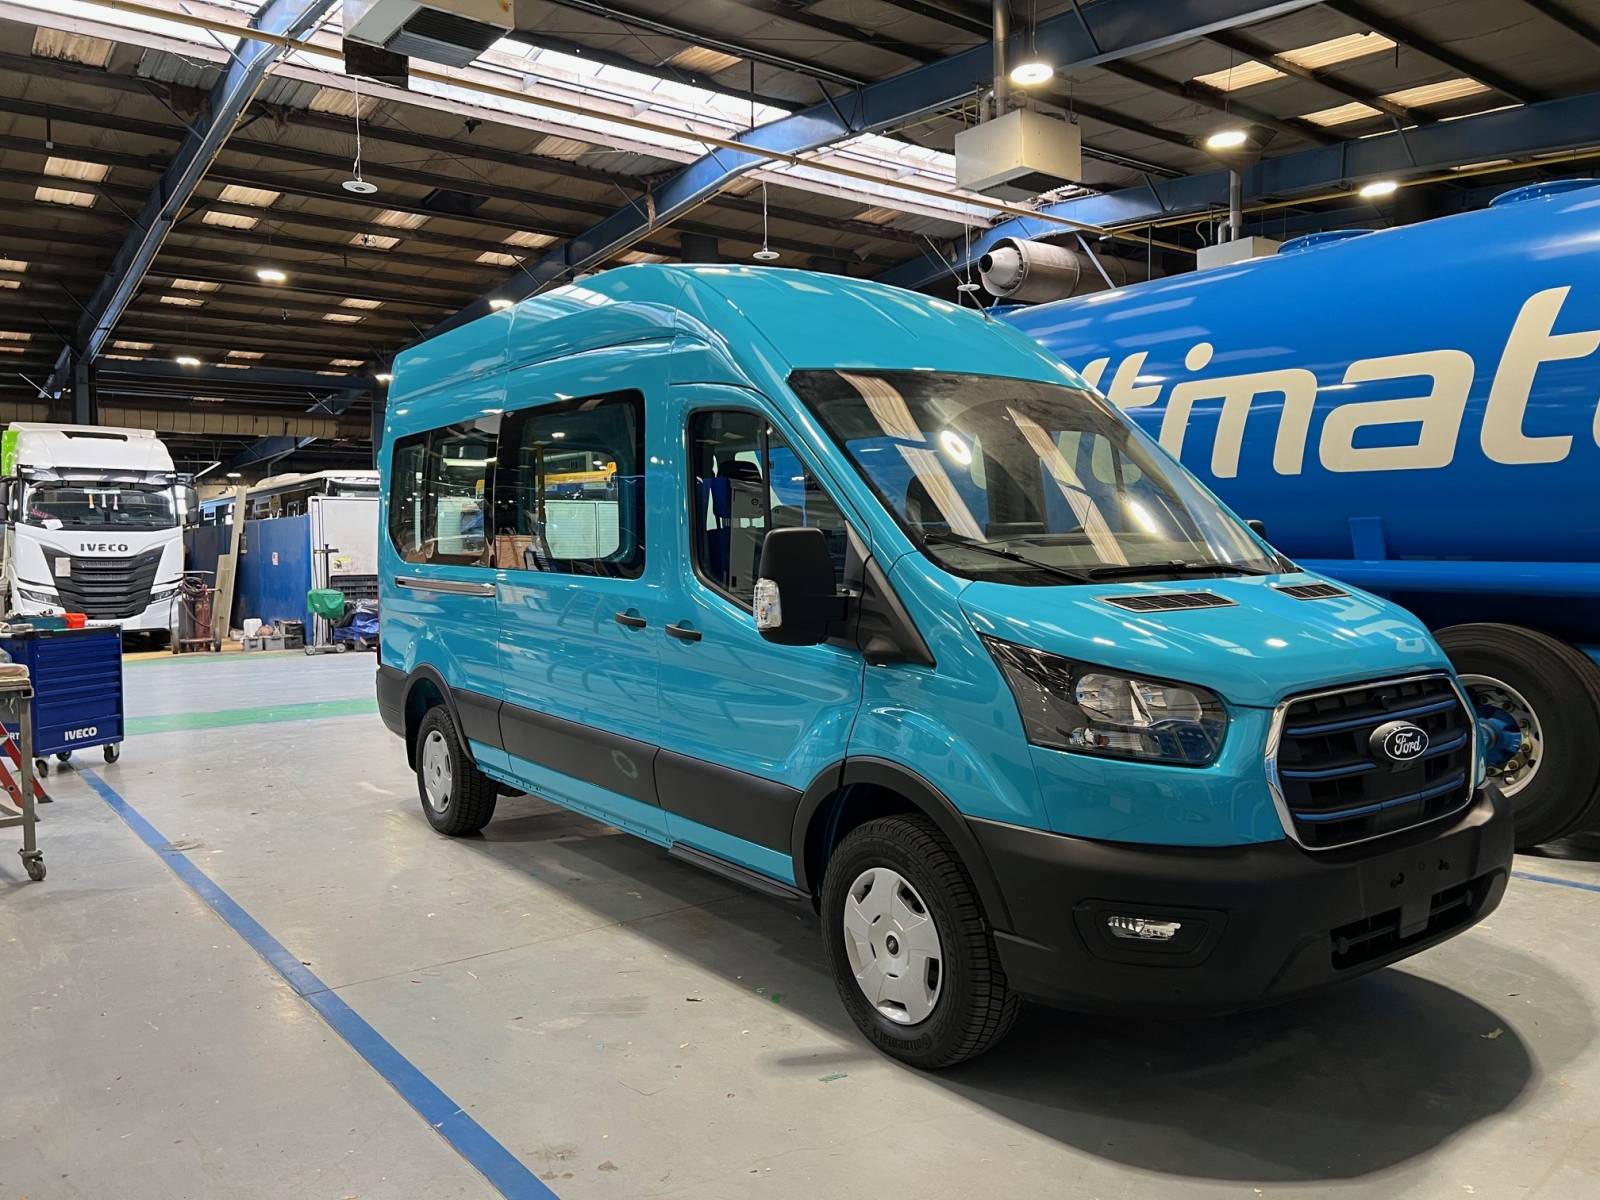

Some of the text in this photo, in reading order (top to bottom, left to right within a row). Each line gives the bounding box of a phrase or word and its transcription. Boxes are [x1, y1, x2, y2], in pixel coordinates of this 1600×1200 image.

[80, 543, 129, 552] IVECO
[64, 726, 98, 742] IVECO
[1394, 732, 1422, 756] Ford
